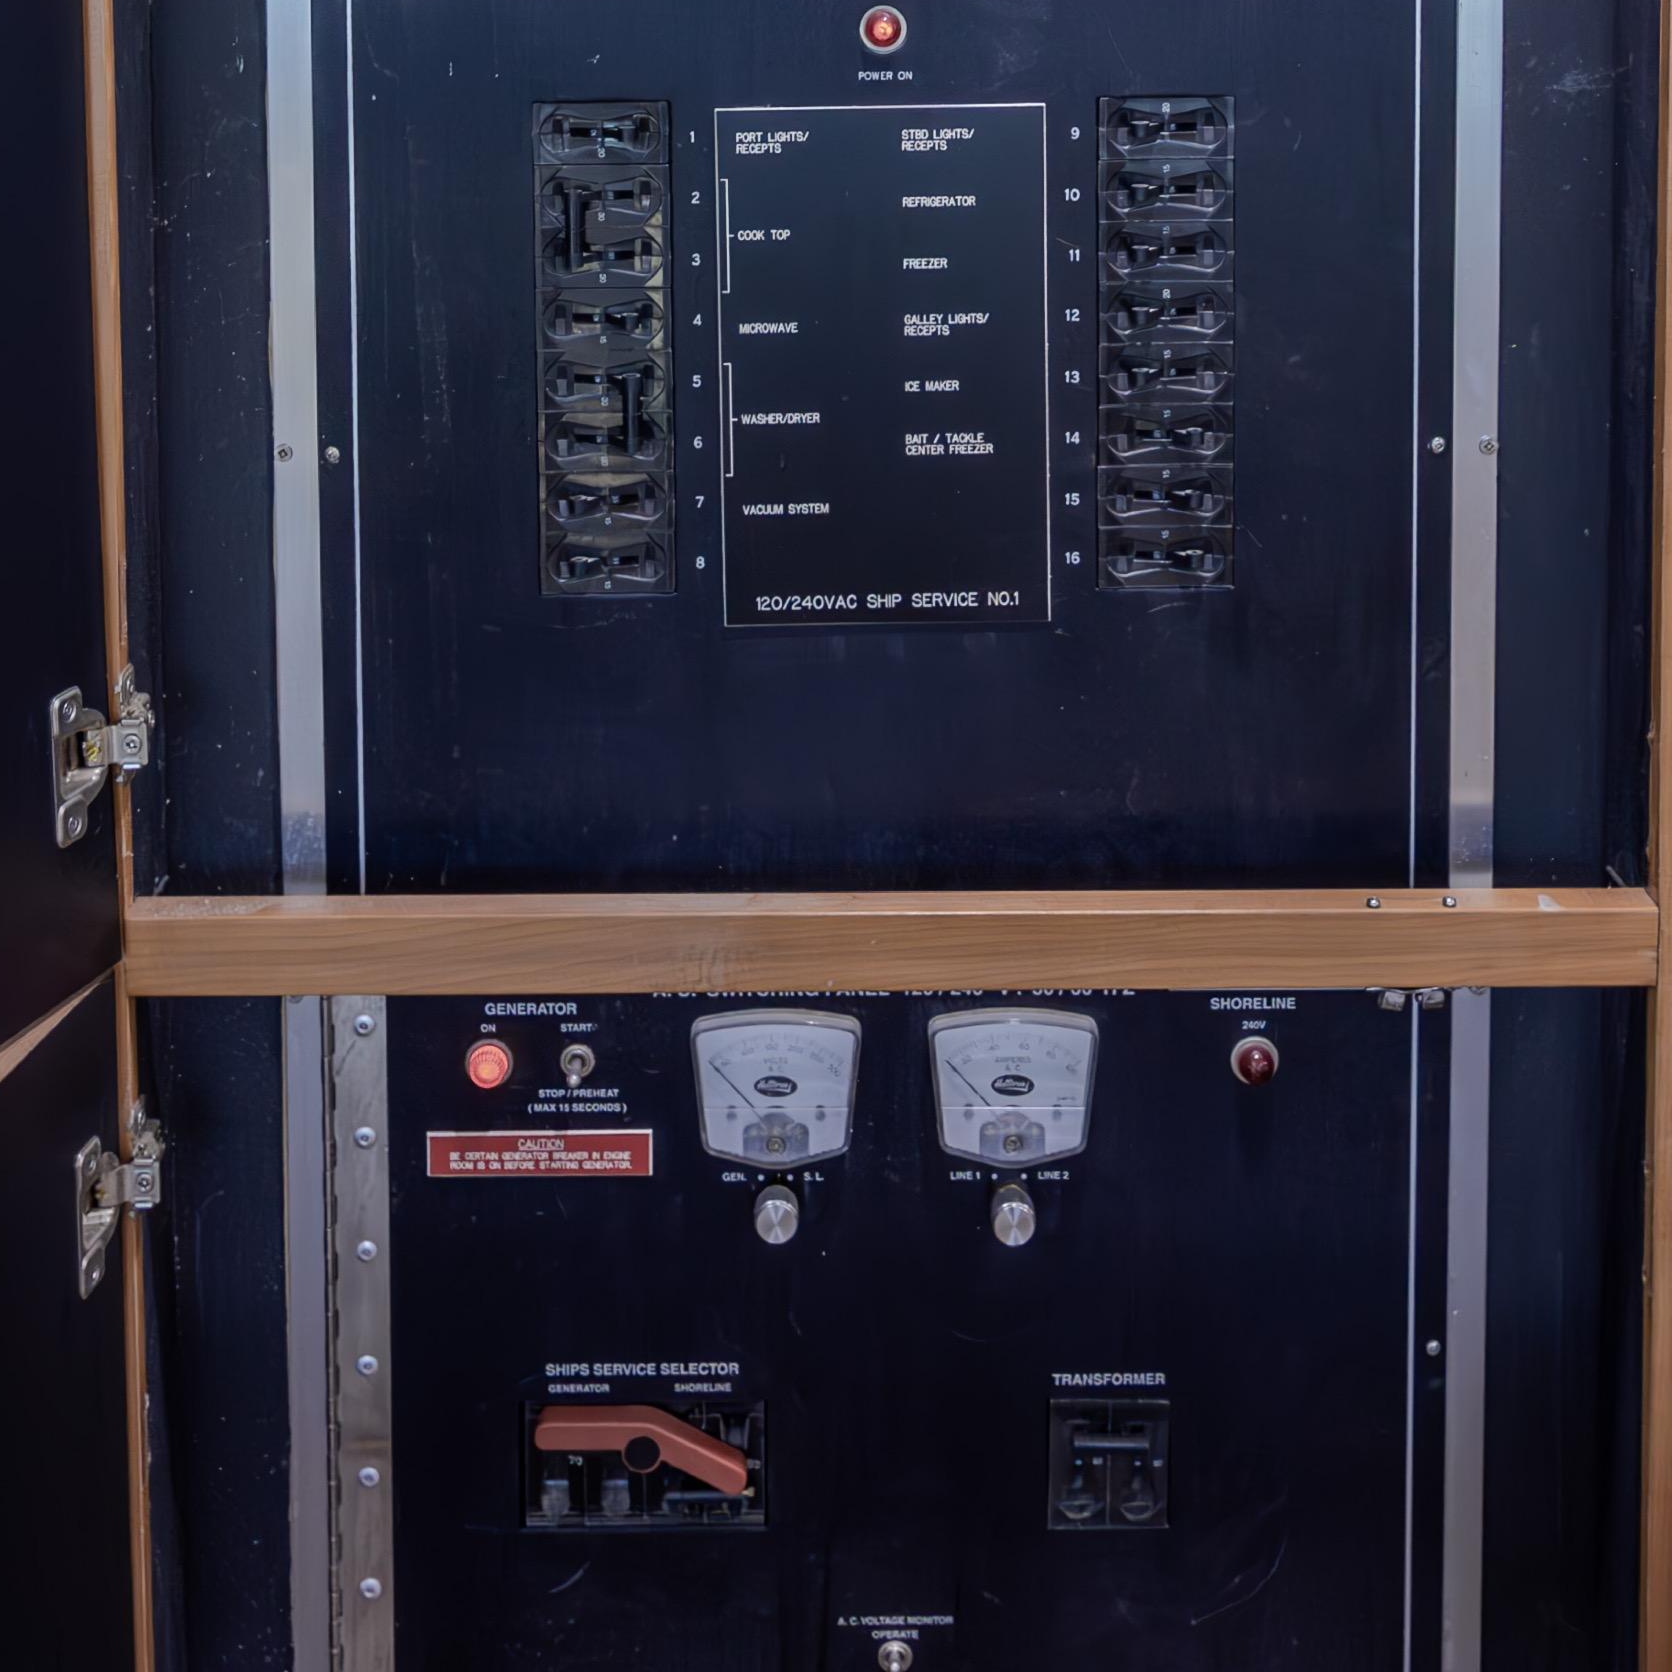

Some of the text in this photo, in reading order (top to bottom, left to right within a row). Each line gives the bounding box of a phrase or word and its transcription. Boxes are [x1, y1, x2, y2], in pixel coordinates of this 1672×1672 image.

[857, 70, 913, 81] POWER ON
[689, 130, 695, 143] 1
[735, 130, 810, 143] PORT LIGHTS/
[901, 127, 975, 140] STBD LIGHTS/
[1070, 126, 1081, 140] 9
[735, 142, 782, 155] RECEPTS
[901, 139, 948, 152] RECEPTS
[690, 191, 700, 205] 2
[1064, 187, 1081, 202] 10
[902, 195, 976, 208] REFRIGERATOR
[737, 228, 791, 241] COOK TOP
[691, 252, 701, 267] 3
[1068, 248, 1080, 262] 11
[902, 257, 948, 270] FREEZER
[692, 313, 702, 326] 4
[903, 312, 990, 325] GALLEY LIGHTS/
[1064, 308, 1080, 322] 12
[738, 322, 799, 335] MICROWAVE
[903, 324, 951, 337] RECEPTS
[692, 374, 702, 388] 5
[1064, 370, 1080, 384] 13
[904, 379, 960, 392] ICE MAKER
[740, 412, 821, 425] WASHER/DRYER
[693, 435, 703, 449] 6
[905, 432, 985, 445] BAIT / TACKLE
[1065, 431, 1080, 445] 14
[905, 443, 994, 456] CENTER FREEZER
[695, 495, 705, 509] 7
[1064, 492, 1080, 506] 15
[742, 502, 830, 516] VACUUM SYSTEM
[695, 555, 706, 570] 8
[1065, 551, 1081, 565] 16
[755, 590, 1019, 611] 120/240VAC SHIP SERVICE NO.1
[484, 1002, 577, 1016] GENERATOR
[1210, 996, 1297, 1010] SHORELINE
[480, 1023, 497, 1033] ON
[560, 1022, 593, 1033] START
[1241, 1020, 1267, 1030] 240V
[538, 1088, 620, 1099] STOP PREHEAT
[533, 1102, 622, 1113] MAX 15 SECONDS
[518, 1139, 564, 1149] CAUTION
[949, 1170, 981, 1181] LINE 1
[1037, 1170, 1070, 1180] LINE 2
[545, 1362, 740, 1377] SHIPS SERVICE SELECTOR
[1051, 1372, 1166, 1386] TRANSFORMER
[547, 1383, 610, 1394] GENERATOR
[674, 1382, 732, 1393] SHORELINE
